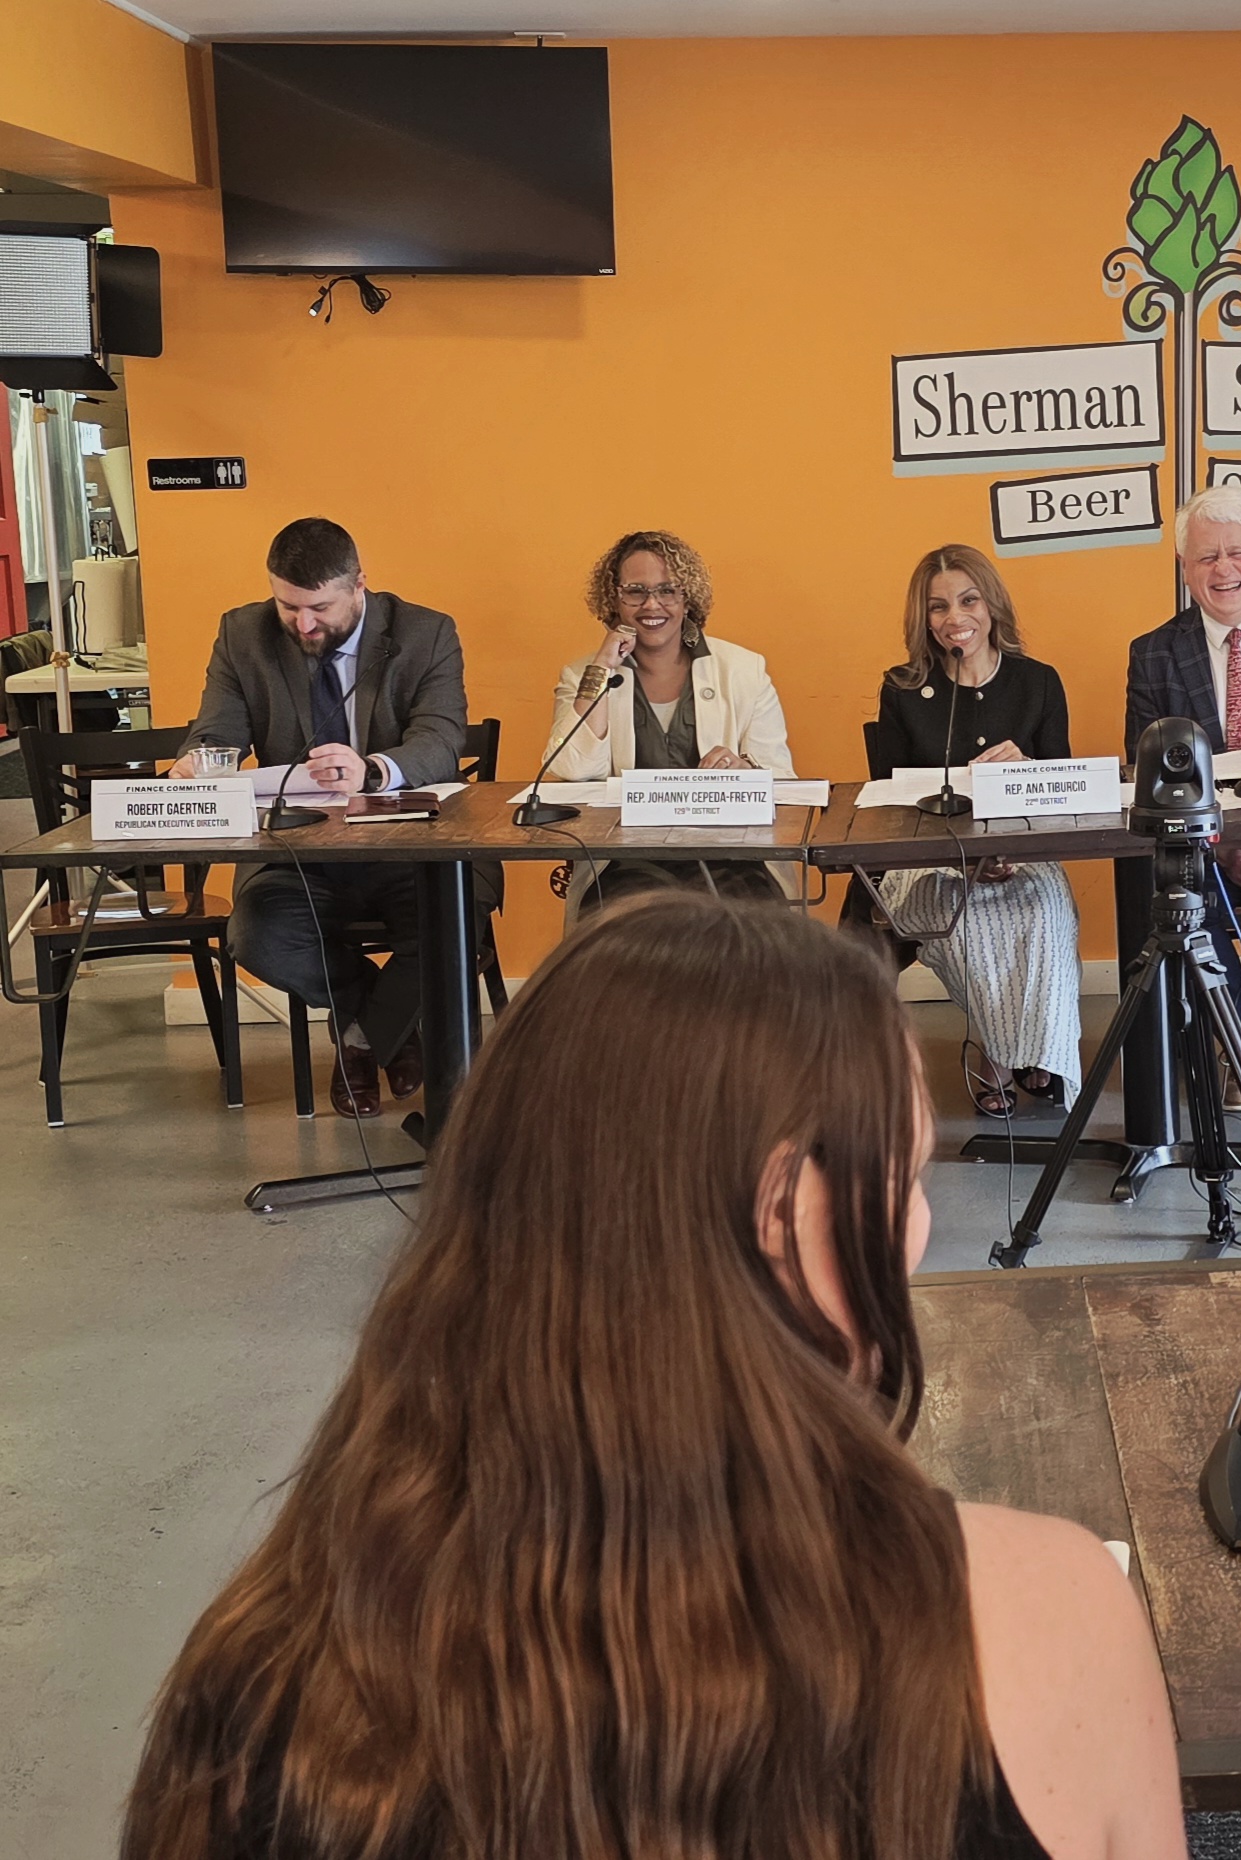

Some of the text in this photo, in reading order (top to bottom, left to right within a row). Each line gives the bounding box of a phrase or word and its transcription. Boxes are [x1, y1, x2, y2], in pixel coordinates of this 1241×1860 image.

[912, 371, 1146, 439] Sherman
[152, 476, 202, 486] Restrooms
[1026, 488, 1131, 523] Beer
[166, 784, 218, 792] COMMITTEE
[1005, 780, 1086, 795] REP. ANA TIBURCIO
[627, 792, 767, 803] REP. JOHANNY CEPEDA-FREYTIZ
[1040, 797, 1068, 805] DISTRICT
[127, 802, 217, 816] ROBERT GAERTNER
[115, 819, 229, 828] REPUBLICAN EXECUTIVE DIRECTOR
